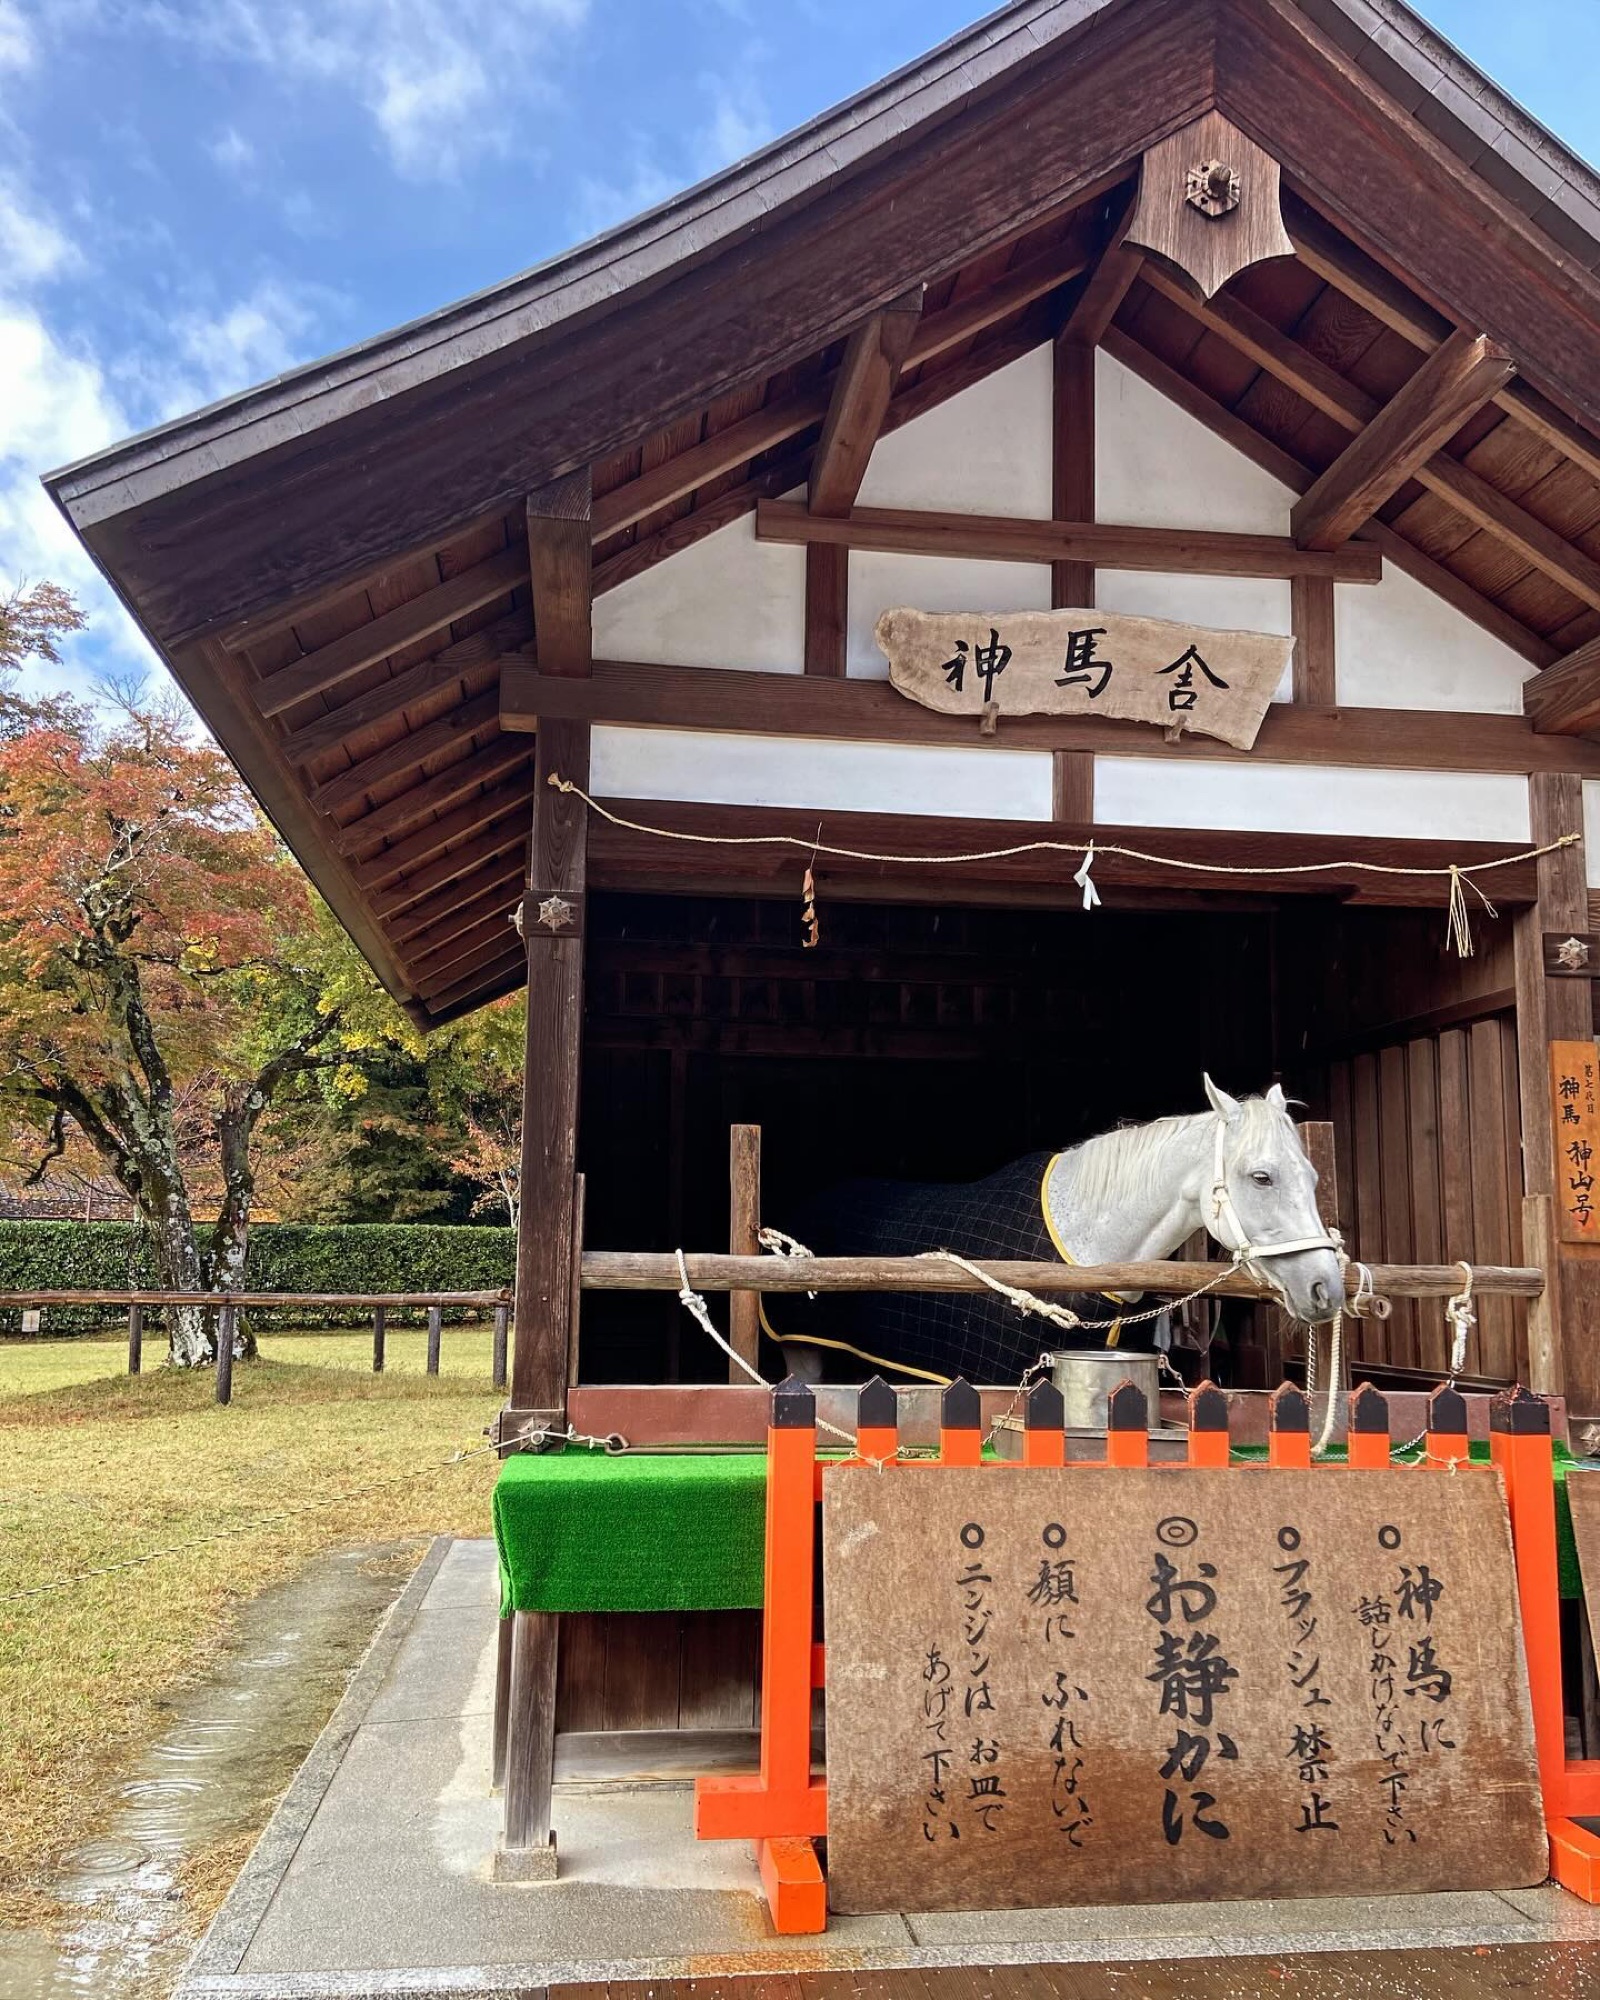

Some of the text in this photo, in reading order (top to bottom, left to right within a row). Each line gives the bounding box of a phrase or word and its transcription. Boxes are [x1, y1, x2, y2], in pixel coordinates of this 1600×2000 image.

[941, 628, 1230, 711] 神馬舎
[1558, 1075, 1595, 1226] 神馬 神山号
[922, 1642, 960, 1842] あげて下さい
[956, 1563, 1006, 1832] ニンジンは お皿で
[1026, 1559, 1093, 1848] 顔に ふれないで
[1145, 1552, 1239, 1846] お静かに
[1272, 1559, 1339, 1833] フラッシュ禁止
[1352, 1595, 1417, 1845] 話しかけないで下さい
[1394, 1565, 1456, 1752] 神馬に
